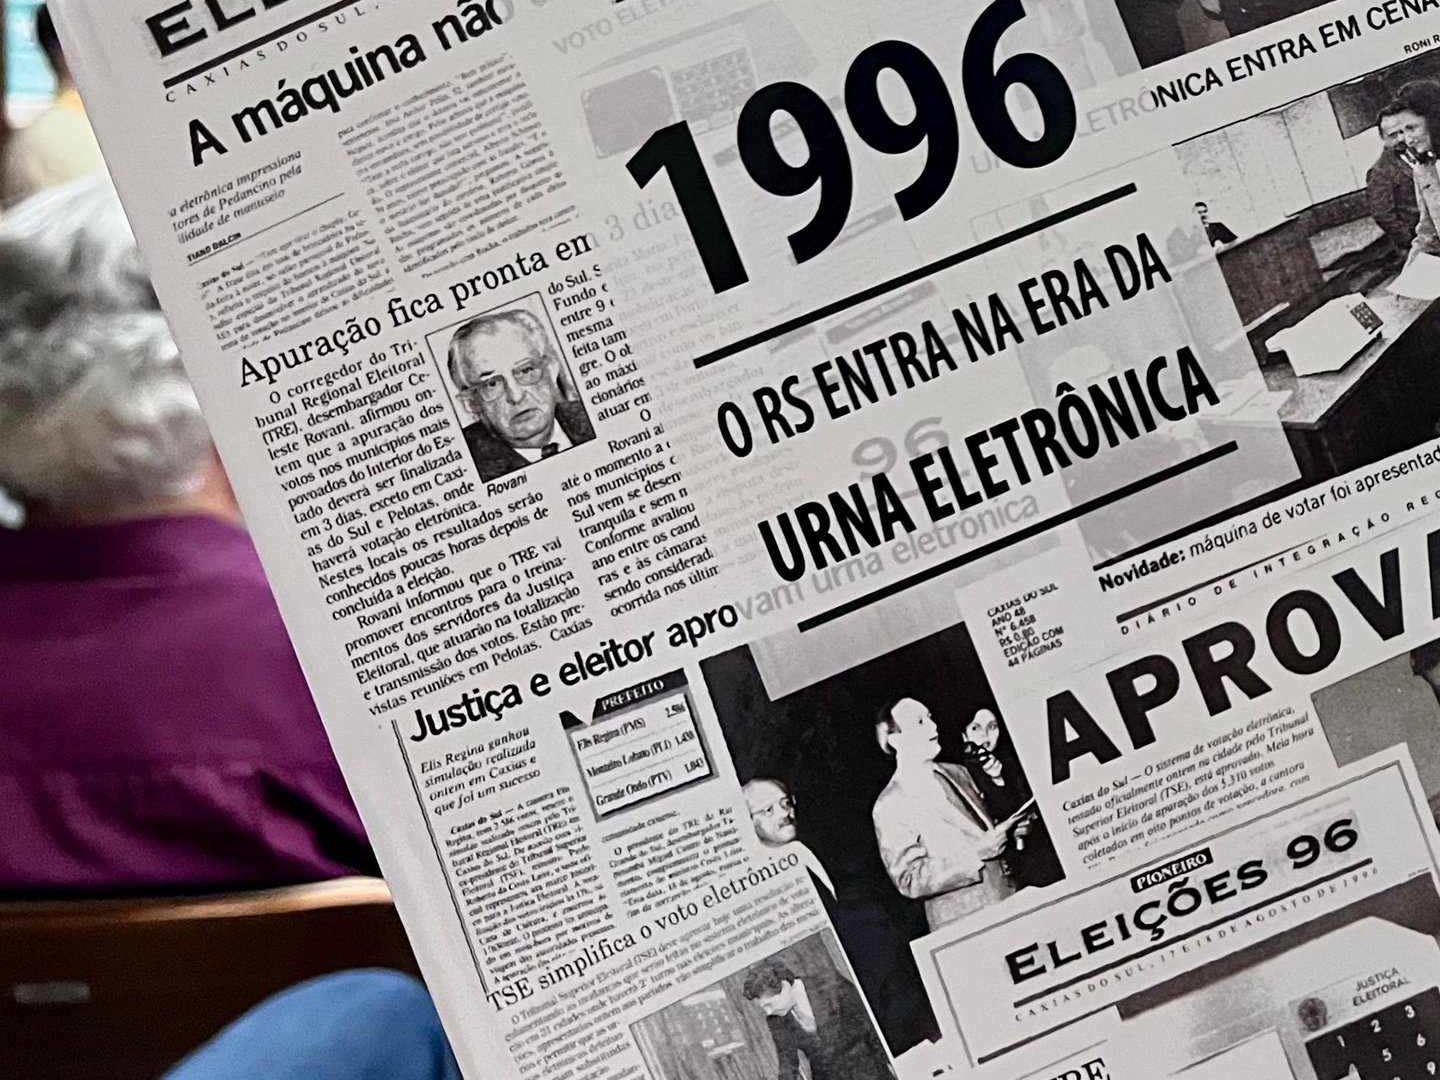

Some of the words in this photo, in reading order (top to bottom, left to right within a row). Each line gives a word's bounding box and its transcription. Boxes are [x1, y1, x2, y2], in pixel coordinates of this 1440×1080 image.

[1225, 33, 1318, 82] ENTRA
[1318, 14, 1362, 49] EM
[1403, 38, 1432, 54] RONI
[188, 118, 229, 167] A
[230, 33, 427, 144] máquina
[240, 316, 382, 388] Apuração
[387, 293, 445, 328] fica
[448, 252, 550, 311] pronta
[555, 232, 600, 262] em
[632, 199, 679, 231] dia
[269, 391, 281, 404] O
[287, 360, 362, 398] corregedor
[369, 352, 386, 365] do
[717, 401, 753, 458] O
[752, 375, 815, 444] RS
[812, 320, 958, 420] ENTRA
[951, 292, 1025, 363] NA
[1017, 258, 1110, 336] ERA
[1103, 232, 1173, 301] DA
[254, 402, 297, 428] bunal
[301, 377, 362, 411] Regional
[365, 352, 425, 385] Eleitoral
[307, 381, 403, 427] desembargador
[267, 442, 299, 461] leste
[359, 398, 411, 425] afirmou
[757, 472, 917, 582] URNA
[909, 345, 1220, 523] ELETRÔNICA
[486, 474, 528, 498] Rovani
[1098, 549, 1186, 592] Novidade:
[1189, 521, 1258, 557] máquina
[1262, 511, 1282, 529] de
[1285, 493, 1326, 519] votar
[1330, 485, 1352, 502] foi
[356, 602, 402, 629] Rovani
[405, 579, 465, 609] informou
[469, 567, 492, 586] que
[498, 562, 507, 571] o
[508, 545, 539, 566] TRE
[542, 536, 562, 552] vai
[410, 684, 523, 743] Justiça
[529, 673, 552, 697] e
[558, 630, 655, 686] eleitor
[600, 677, 666, 712] PREFEITO
[1004, 859, 1268, 985] ELEIÇÕES
[1286, 818, 1358, 870] 96
[1134, 850, 1210, 892] PIONEIRO
[484, 977, 534, 1011] TSE
[538, 933, 637, 990] simplifica
[640, 925, 652, 939] o
[654, 902, 699, 930] voto
[702, 853, 799, 908] eletrônico
[1368, 1017, 1384, 1035] 2
[1402, 1002, 1418, 1021] 3
[1380, 1046, 1395, 1064] 5
[1413, 1031, 1429, 1049] 6
[1424, 1059, 1440, 1078] 9
